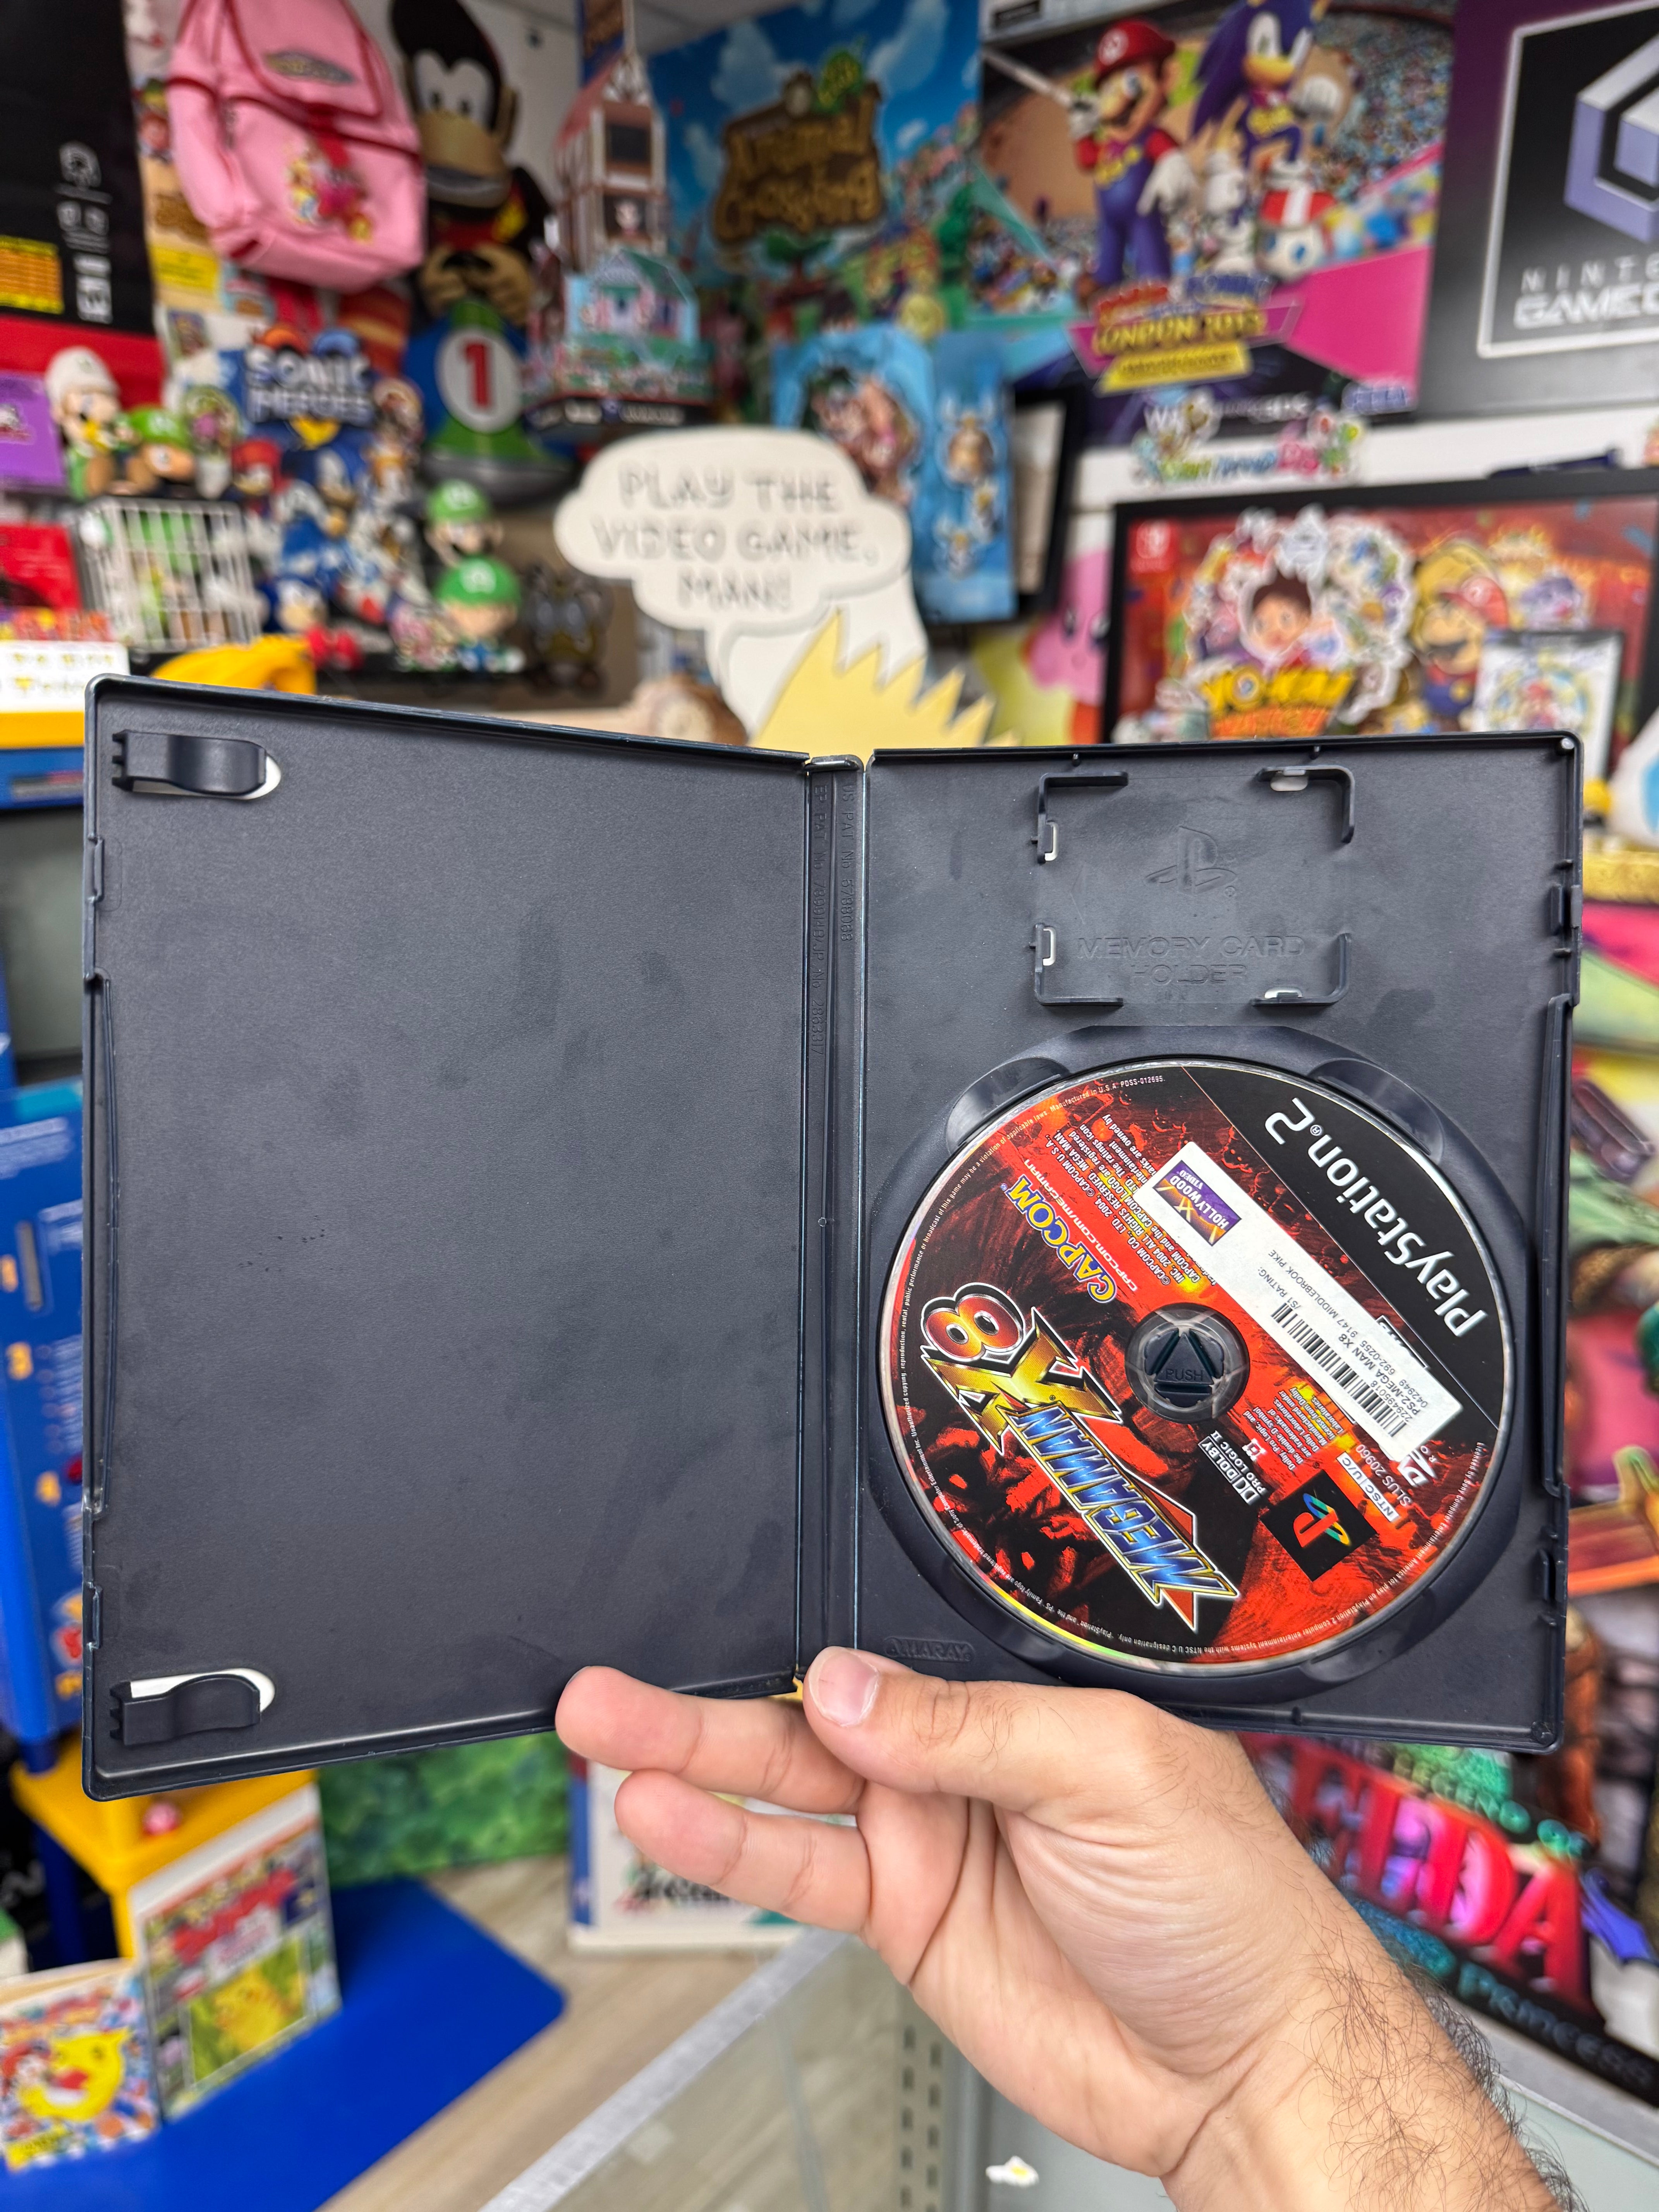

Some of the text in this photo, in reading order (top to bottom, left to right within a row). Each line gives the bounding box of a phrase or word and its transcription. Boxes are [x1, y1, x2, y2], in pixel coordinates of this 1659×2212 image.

[620, 467, 842, 511] PLAY THE
[592, 515, 726, 562] VIDEO
[842, 784, 854, 802] US
[842, 813, 854, 838] PAT
[841, 851, 853, 868] No
[1077, 936, 1305, 958] MEMORY CARD
[1049, 1089, 1090, 1114] Manufactured
[1005, 1116, 1034, 1141] applicable
[1078, 1123, 1095, 1141] icon
[1101, 1112, 1143, 1160] are owned by
[978, 1141, 1001, 1164] violation
[1090, 1136, 1116, 1164] ratings
[1108, 1139, 1149, 1185] ntertainment
[959, 1171, 972, 1185] may
[1110, 1161, 1127, 1178] The
[1178, 1169, 1205, 1190] VIDEO
[941, 1197, 951, 1209] this
[948, 1183, 963, 1199] game
[1168, 1173, 1230, 1230] HOLLYWOOD
[1052, 1129, 1185, 1283] INC. 2004 ALL RIGHTS RESERVED. MEGA MAN,
[1067, 1129, 1201, 1283] CAPCOM and the CAPCOM LOGO are registered
[1092, 1194, 1114, 1218] 2004,
[922, 1214, 941, 1242] broadcast
[1109, 1214, 1127, 1234] LTD.
[1003, 1173, 1122, 1308] CAPCOM
[1122, 1230, 1140, 1250] CO.,
[907, 1250, 925, 1286] performance
[1268, 1249, 1287, 1268] PIKE
[1256, 1266, 1288, 1297] RATING:
[1285, 1266, 1339, 1319] MIDDLEBROOK
[903, 1287, 913, 1305] public
[1336, 1317, 1358, 1338] 9147
[1338, 1333, 1353, 1348] X8
[1351, 1346, 1376, 1370] MAN
[1359, 1339, 1396, 1376] 692-0255
[1165, 1369, 1203, 1381] PUSH
[1369, 1380, 1413, 1422] 229495018
[1373, 1368, 1421, 1415] PS2-MEGA
[1398, 1378, 1428, 1408] 042949
[903, 1398, 917, 1437] Unauthorized
[1271, 1396, 1320, 1452] Dolby Laboratories.
[1277, 1388, 1328, 1446] Manufactured under
[1288, 1385, 1336, 1440] license from Dolby
[1309, 1395, 1344, 1434] Laboratories.
[912, 1437, 921, 1448] Inc.
[1242, 1409, 1297, 1471] Dolby, Pro Logic, and
[1252, 1405, 1304, 1465] the double-D symbol
[1267, 1407, 1312, 1458] are trademarks of
[916, 1448, 937, 1486] Entertainment
[1201, 1438, 1238, 1480] DOLBY
[1219, 1440, 1248, 1472] LOGIC
[1468, 1442, 1484, 1470] Licensed
[1245, 1470, 1266, 1494] PRO
[1340, 1455, 1394, 1517] NTSC U/C
[1354, 1442, 1412, 1508] SLUS 20960
[1457, 1479, 1470, 1494] Sony
[933, 1484, 951, 1510] Computer
[1441, 1494, 1463, 1522] Computer
[946, 1508, 960, 1523] Sony
[959, 1527, 985, 1555] trademarks
[1414, 1522, 1447, 1559] Entertainment
[982, 1552, 1007, 1576] registered
[1395, 1557, 1418, 1579] America
[1004, 1573, 1015, 1583] are
[1013, 1580, 1026, 1592] logo
[1375, 1582, 1389, 1596] play
[1024, 1588, 1044, 1604] Family
[1056, 1609, 1066, 1618] the
[1065, 1614, 1077, 1623] and
[1335, 1597, 1369, 1621] PlayStation
[1116, 1633, 1132, 1643] only.
[1257, 1630, 1301, 1648] entertainment
[1302, 1618, 1330, 1635] computer
[1133, 1637, 1170, 1650] designation
[1230, 1641, 1256, 1652] systems
